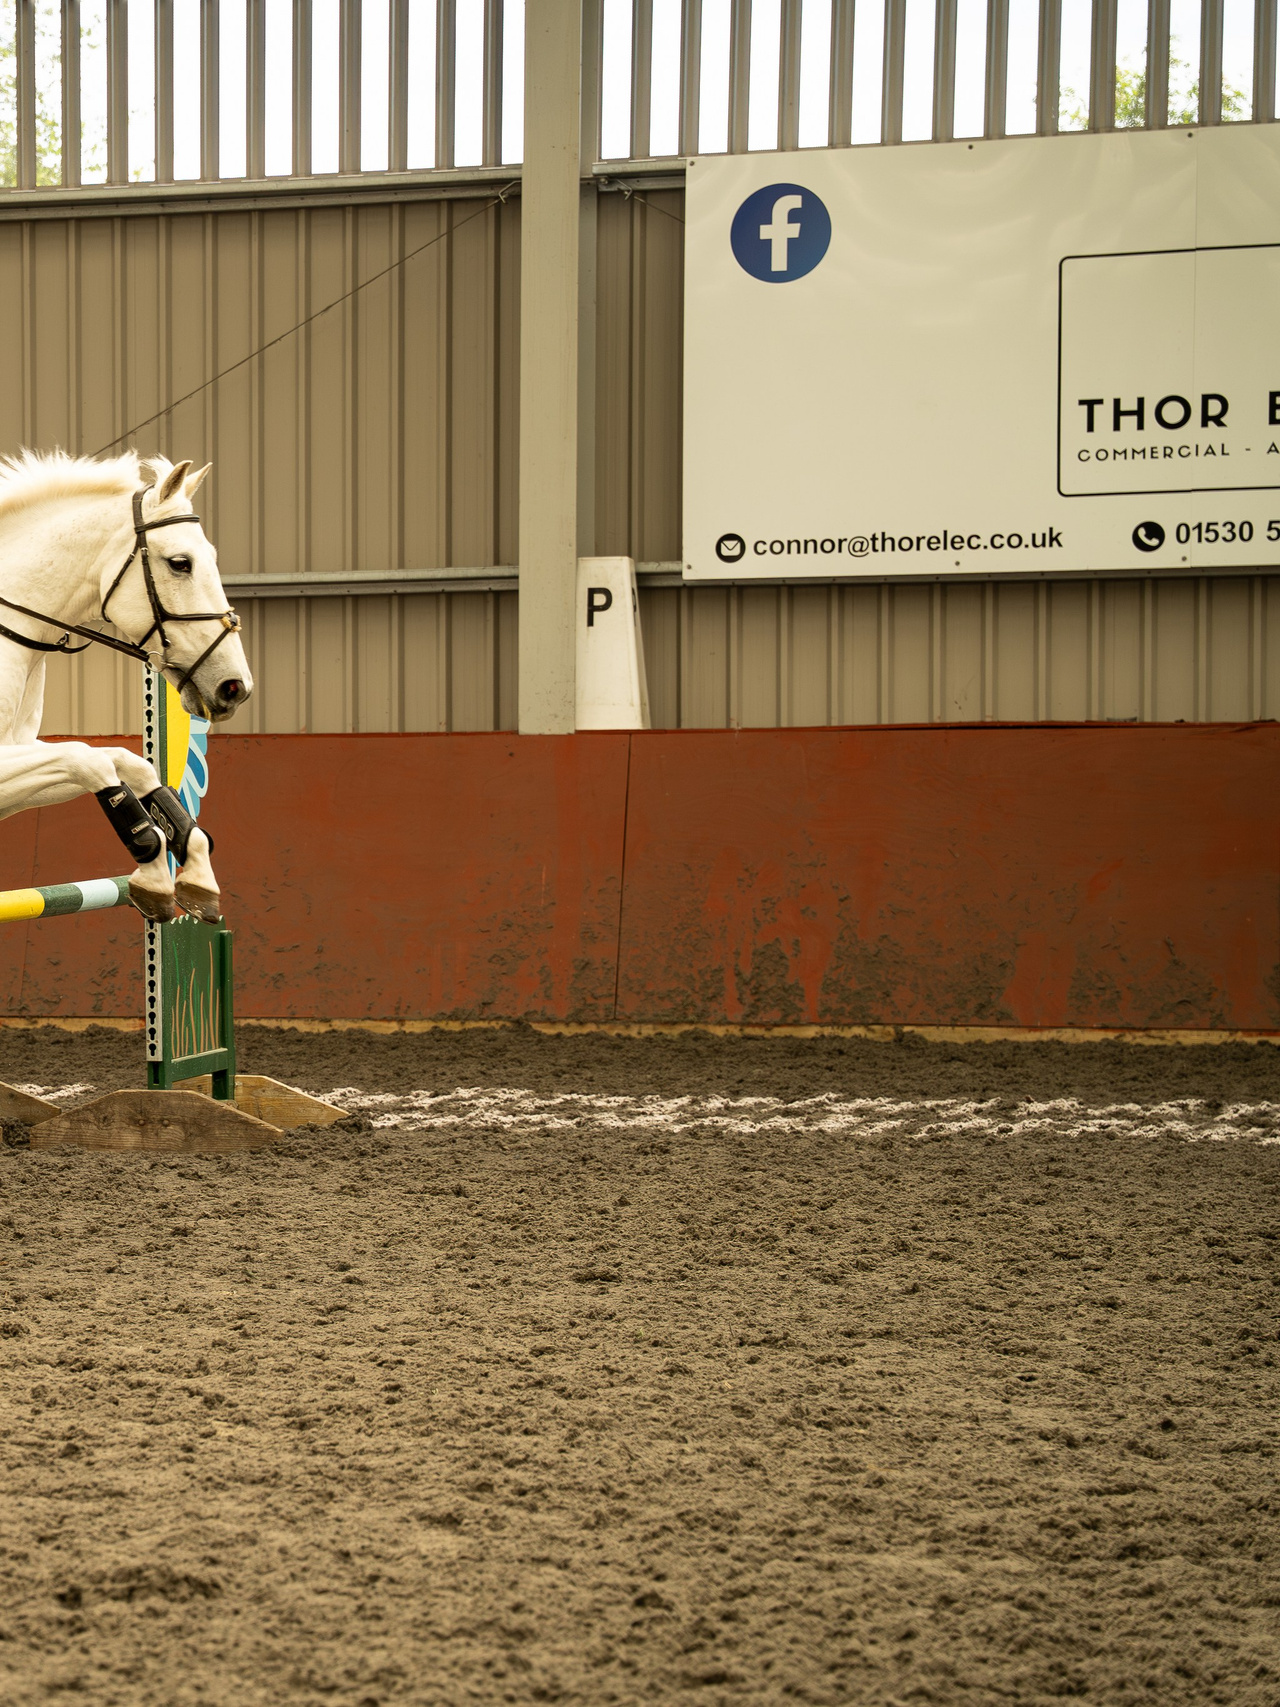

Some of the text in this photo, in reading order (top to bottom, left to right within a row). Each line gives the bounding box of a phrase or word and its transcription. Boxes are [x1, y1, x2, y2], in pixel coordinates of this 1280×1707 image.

[1077, 392, 1229, 433] THOR
[1077, 443, 1231, 463] COMMERCIAL
[753, 526, 1064, 558] connor@thorelec.co.uk
[1175, 520, 1254, 544] 01530
[586, 587, 613, 627] P
